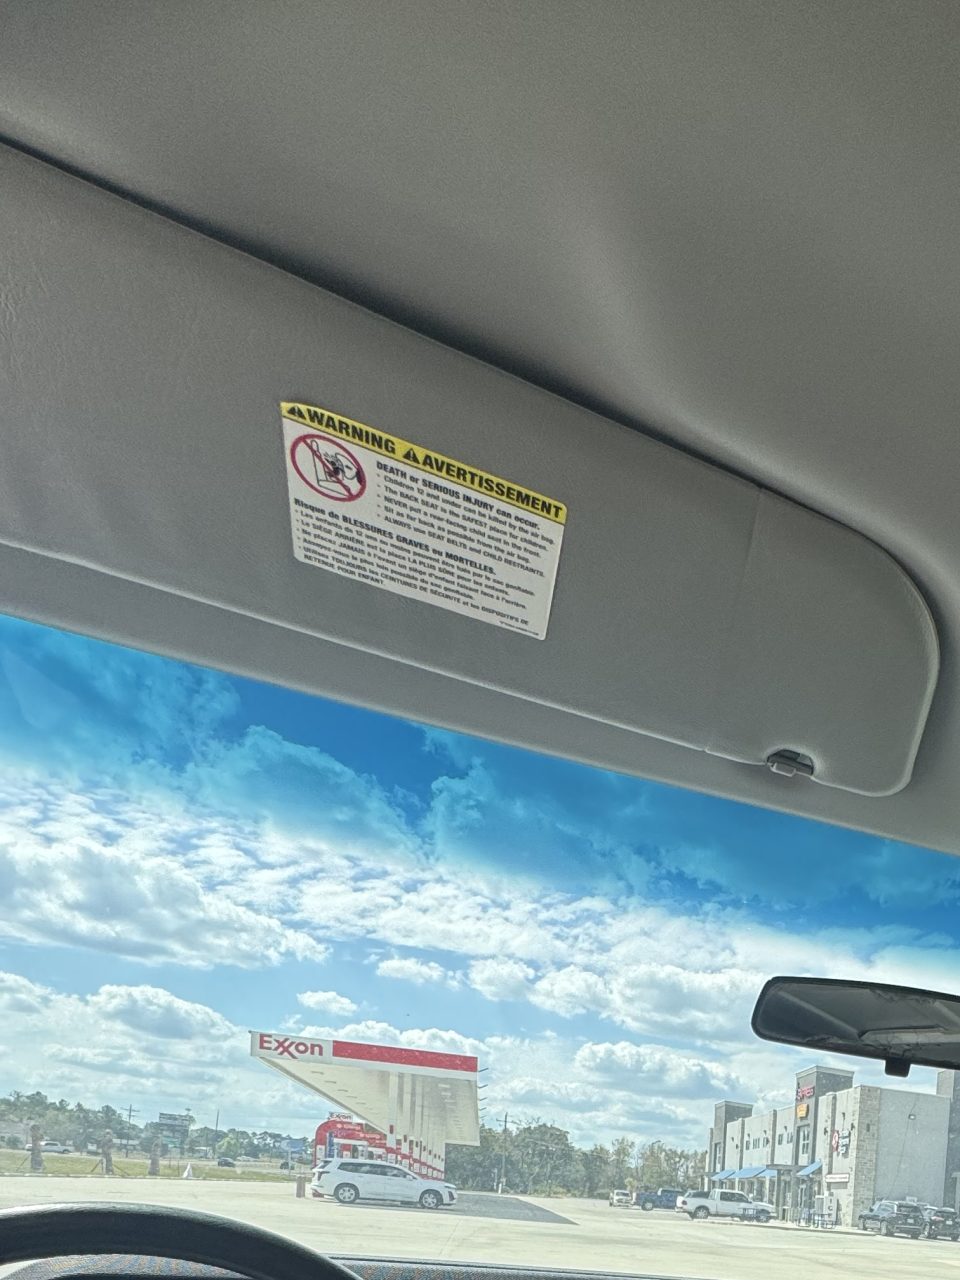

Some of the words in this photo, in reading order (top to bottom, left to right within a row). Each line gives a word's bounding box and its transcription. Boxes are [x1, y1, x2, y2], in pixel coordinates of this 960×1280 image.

[307, 408, 396, 455] WARNING
[422, 454, 563, 519] AVERTISSEMENT
[377, 461, 407, 480] DEATH
[410, 475, 418, 484] or
[422, 479, 460, 500] SERIOUS
[463, 494, 494, 513] INJURY
[496, 509, 512, 519] can
[514, 516, 540, 530] occur.
[295, 498, 325, 517] Risque
[328, 510, 339, 520] de
[342, 515, 393, 539] BLESSURES
[396, 534, 429, 552] GRAVES
[432, 548, 443, 556] ou
[445, 552, 497, 575] MORTELLES.
[384, 475, 414, 492] Children
[417, 487, 424, 496] 12
[427, 491, 439, 501] and
[442, 497, 461, 509] under
[464, 506, 476, 515] can
[478, 510, 487, 519] be
[489, 514, 506, 526] killed
[509, 522, 516, 531] by
[519, 526, 529, 534] the
[530, 530, 539, 538] air
[385, 485, 397, 496] The
[400, 491, 419, 503] BACK
[421, 499, 438, 511] SEAT
[441, 506, 447, 514] is
[449, 509, 460, 518] the
[462, 514, 487, 528] SAFEST
[489, 524, 508, 537] place
[509, 532, 518, 540] for
[259, 1033, 323, 1059] Exxon
